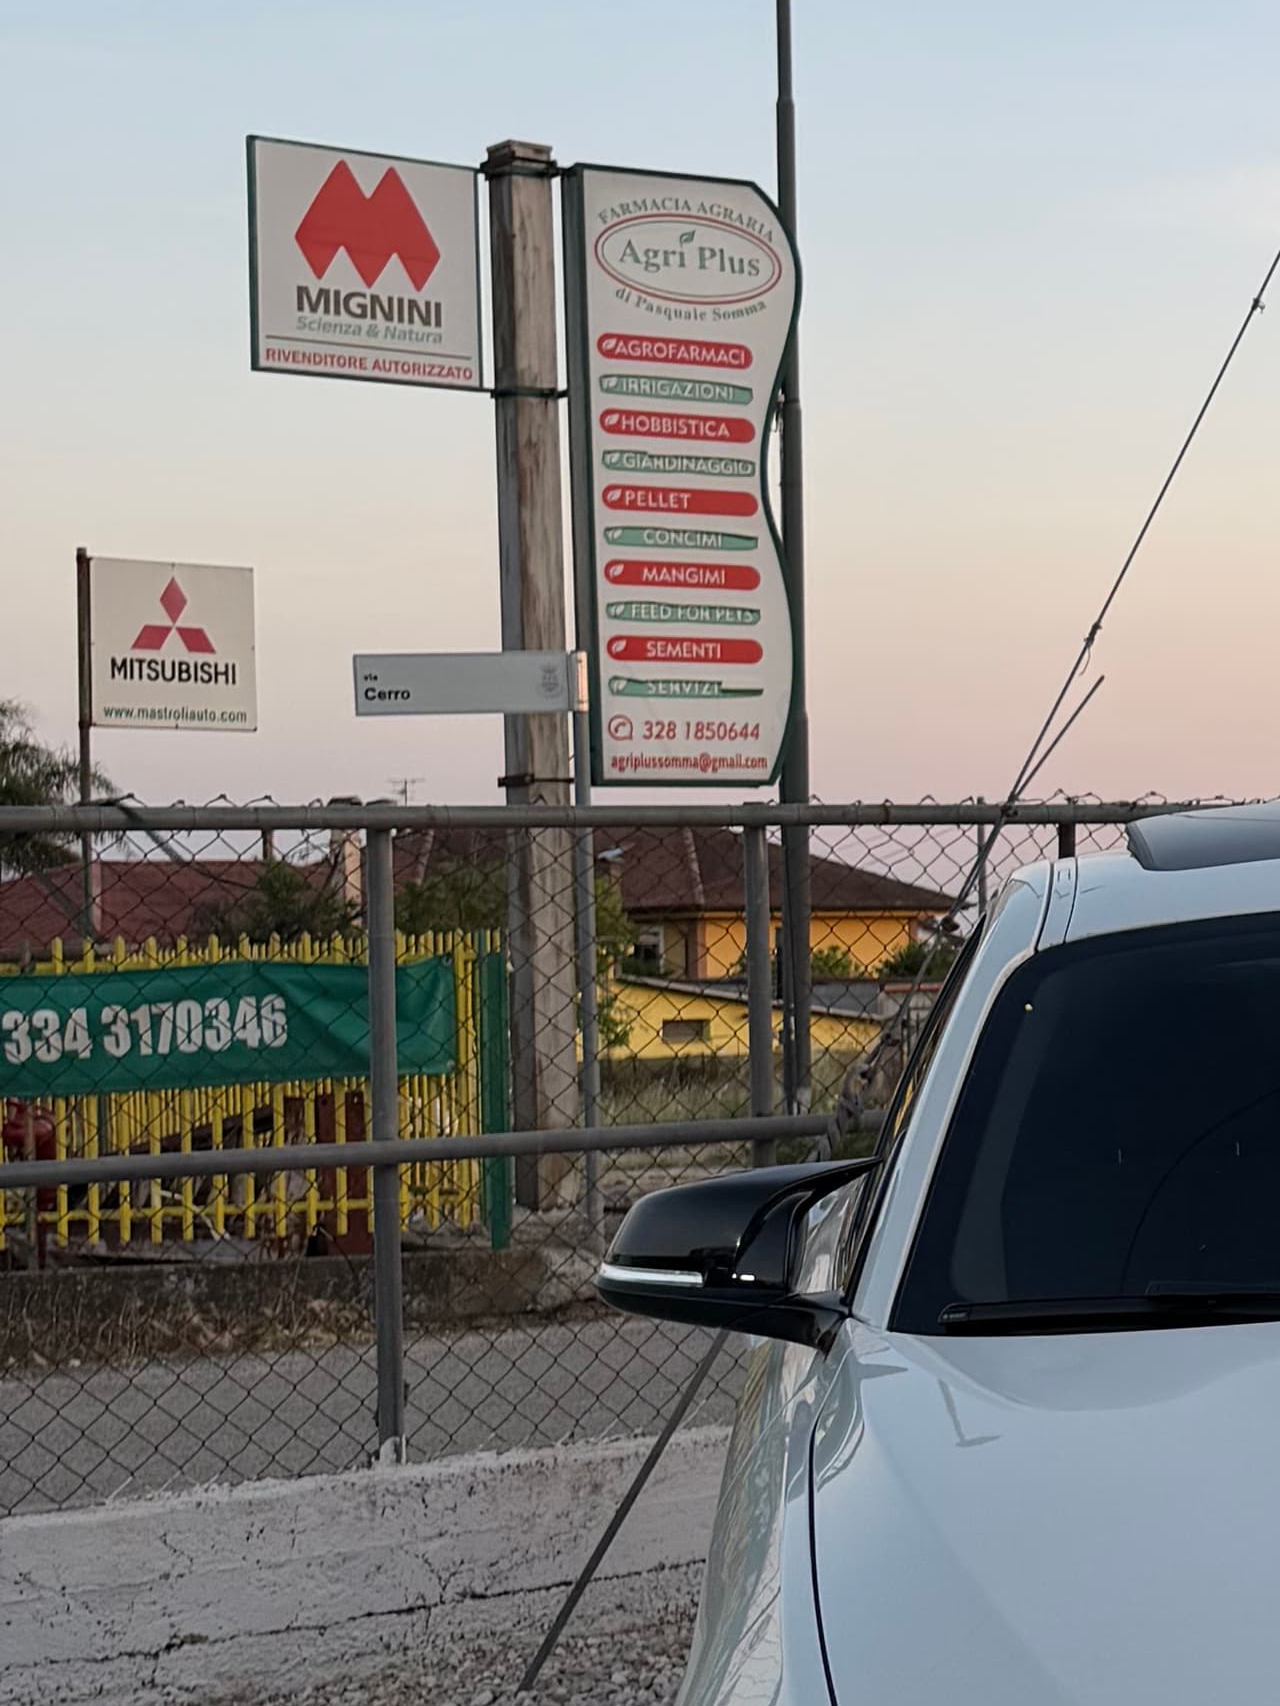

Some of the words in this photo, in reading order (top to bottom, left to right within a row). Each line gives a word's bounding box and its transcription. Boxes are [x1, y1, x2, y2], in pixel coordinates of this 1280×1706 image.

[597, 197, 692, 225] FARMACIA
[697, 201, 773, 242] AGRARIA
[619, 238, 686, 273] Agri
[698, 246, 760, 277] Plus
[296, 285, 442, 328] MIGNINI
[615, 288, 632, 303] di
[635, 296, 707, 321] Pasquale
[712, 300, 767, 321] Somma
[296, 316, 362, 337] Scienza
[365, 324, 381, 338] &
[384, 326, 442, 344] Natura
[265, 347, 367, 371] RIVENDITORE
[371, 359, 473, 380] AUTORIZZATO
[614, 340, 745, 365] AGROFARMACI
[622, 378, 734, 400] IRRIGAZIONI
[621, 414, 730, 438] HOBBISTICA
[624, 490, 691, 509] PELLET
[643, 529, 722, 547] CONCIMI
[642, 566, 725, 585] MANGIMI
[631, 604, 671, 620] FEED
[646, 640, 721, 659] SEMENTI
[110, 657, 236, 685] MITSUBISHI
[364, 687, 411, 701] Cerro
[104, 705, 247, 723] www.mastroliauto.com
[643, 720, 677, 740] 328
[686, 721, 761, 741] 1850644
[611, 752, 768, 773] agriplussomma@gmail.com
[2, 1008, 93, 1065] 334
[101, 993, 288, 1059] 3170346
